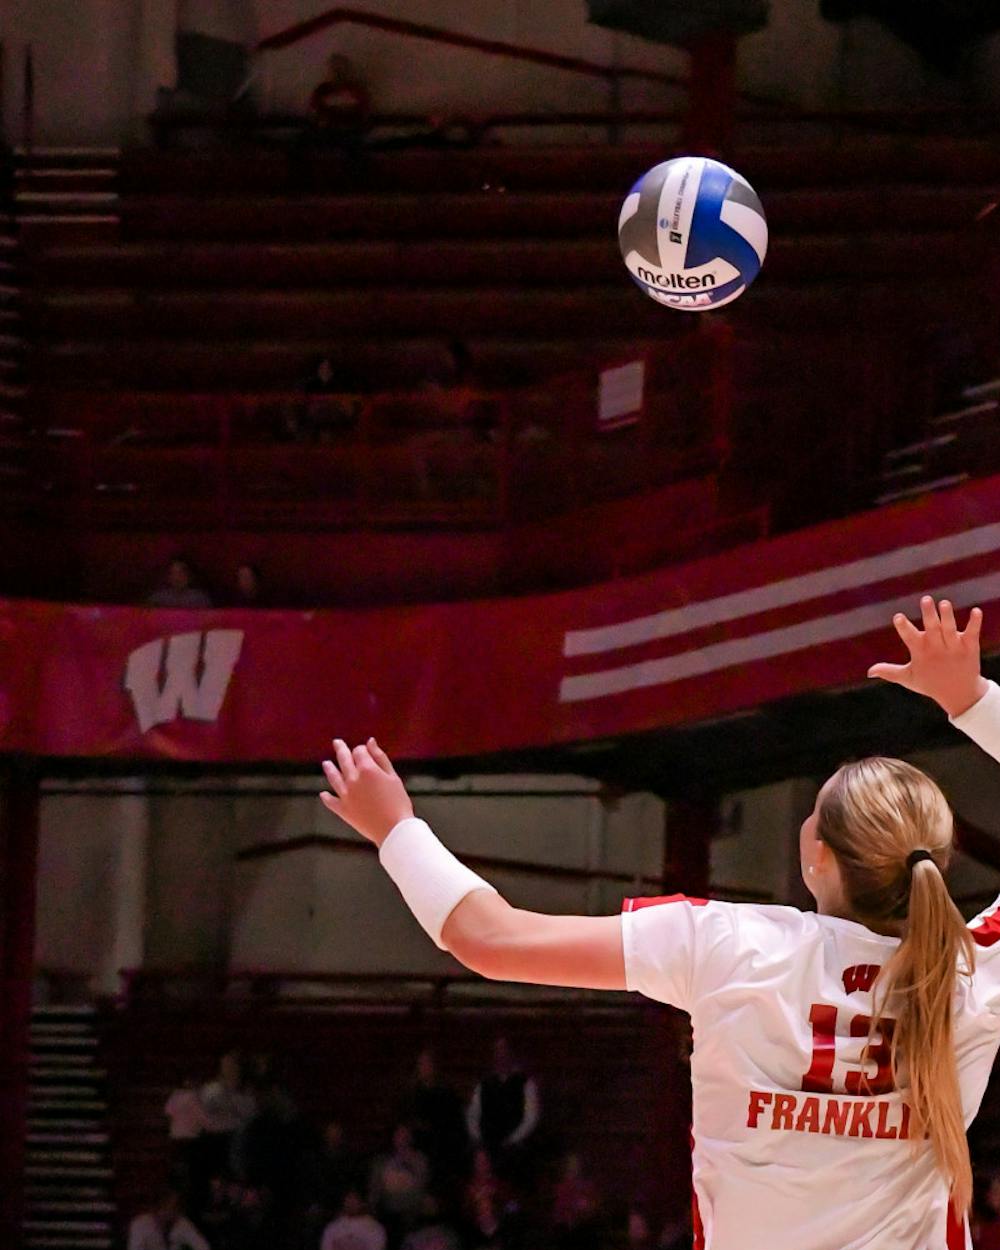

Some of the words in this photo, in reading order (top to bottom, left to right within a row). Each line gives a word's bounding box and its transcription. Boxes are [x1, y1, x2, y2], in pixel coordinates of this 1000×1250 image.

[638, 267, 716, 289] molten
[124, 629, 245, 735] W
[842, 964, 882, 995] W
[801, 1004, 898, 1097] 13
[747, 1091, 926, 1140] FRANKLI
